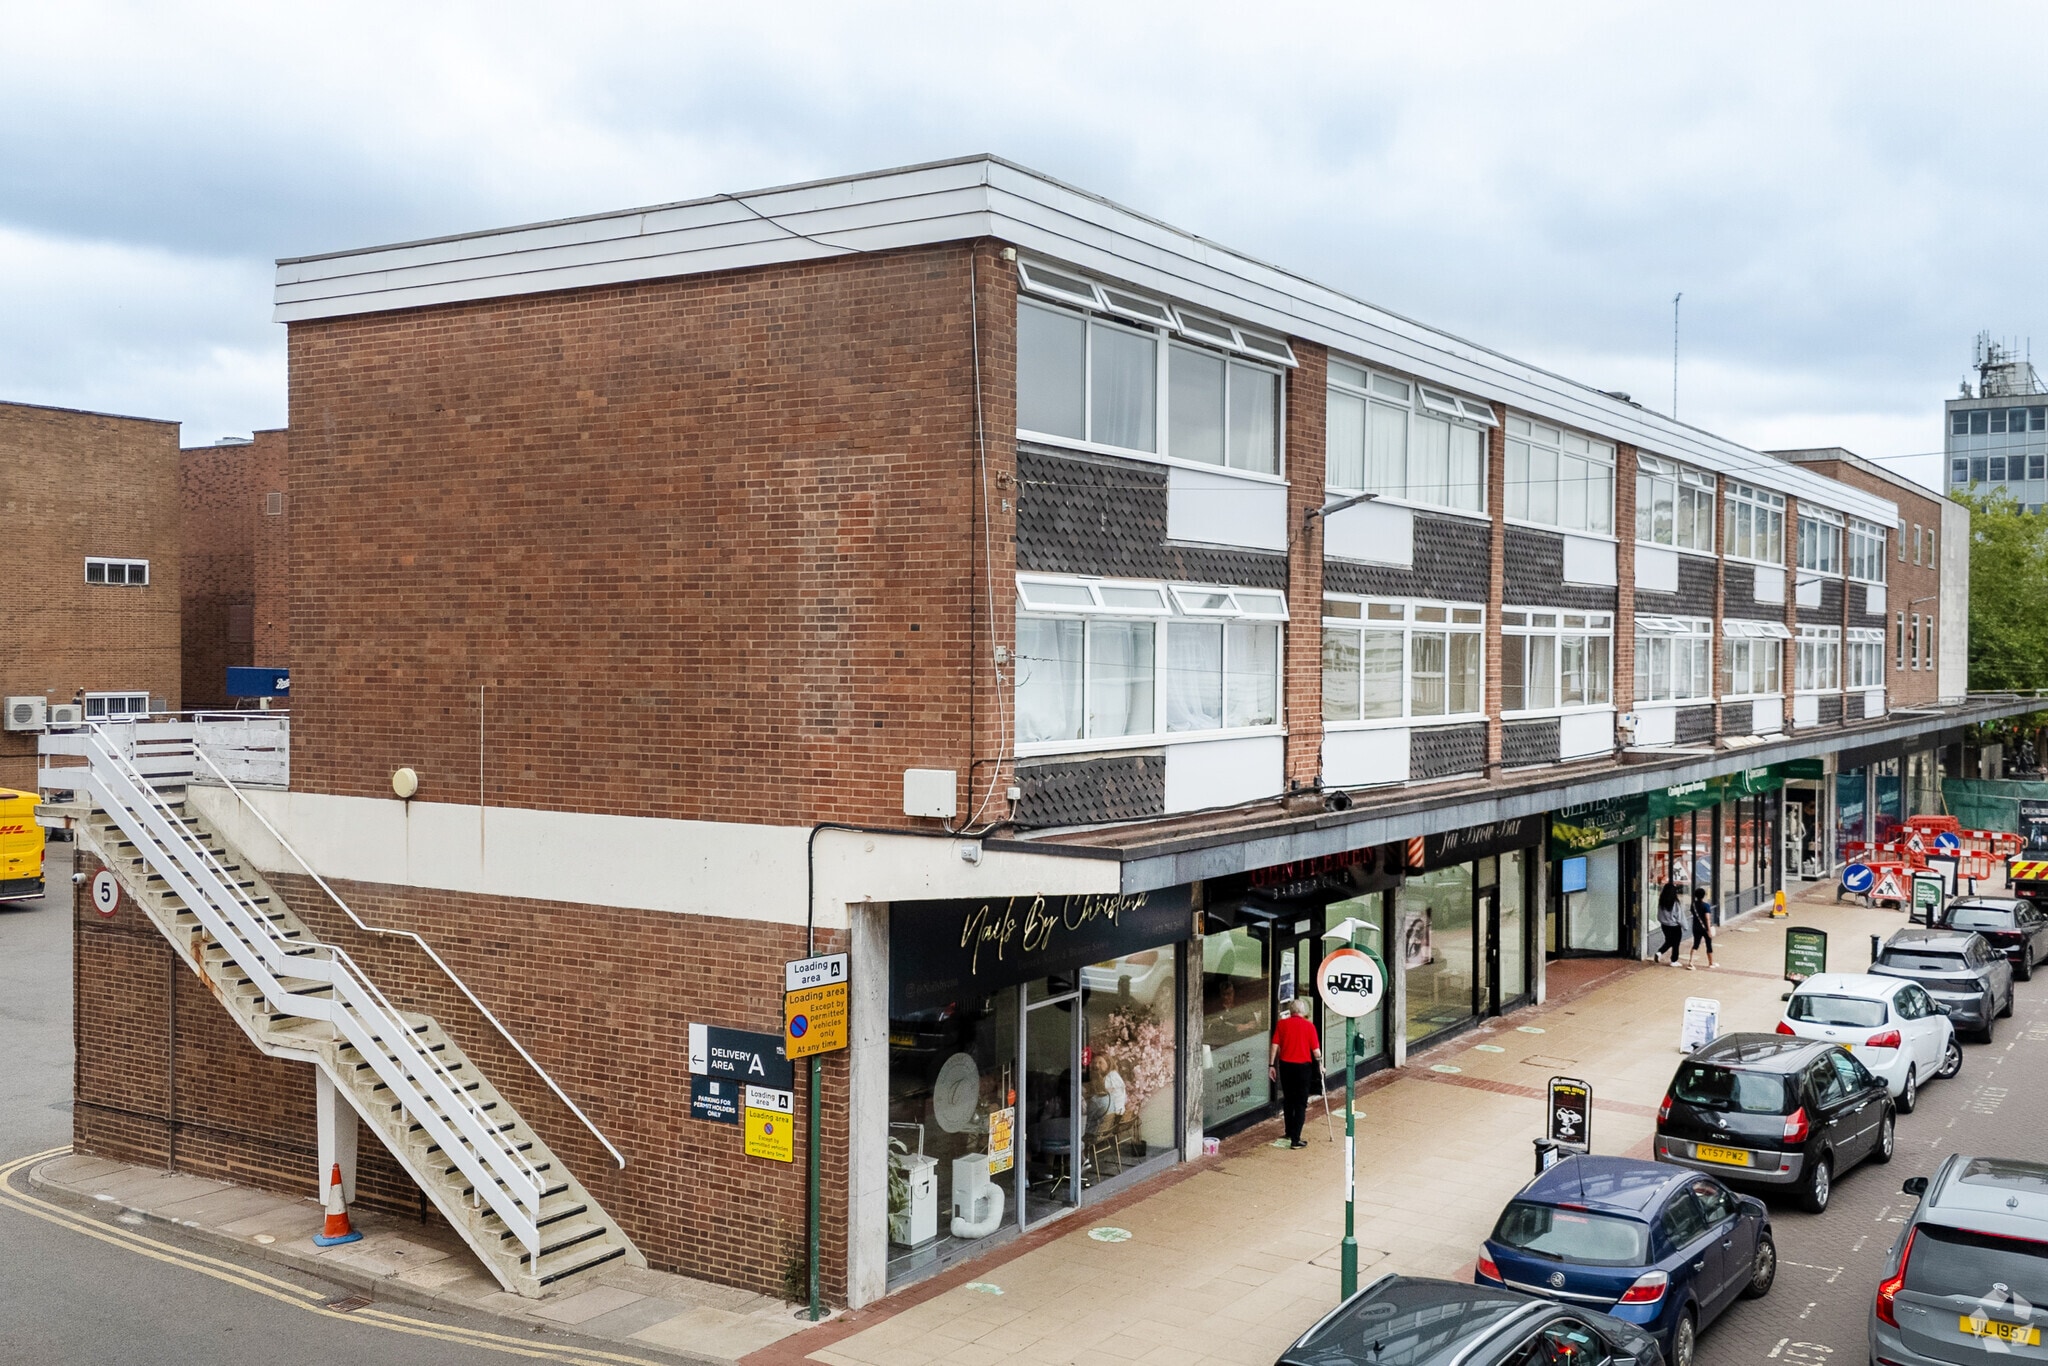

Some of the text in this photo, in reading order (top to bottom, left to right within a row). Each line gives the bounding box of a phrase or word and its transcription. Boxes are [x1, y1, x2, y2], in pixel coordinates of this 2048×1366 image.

[275, 678, 290, 689] Boo
[1596, 810, 1626, 827] CLEANERS
[0, 825, 25, 835] HL
[1462, 825, 1495, 846] Brow
[1497, 820, 1522, 838] Bar
[100, 881, 111, 903] 5
[960, 896, 1017, 976] Nails
[1022, 896, 1059, 952] By
[1063, 890, 1150, 931] Christina
[794, 961, 840, 975] Loading A
[801, 974, 821, 984] area
[1340, 973, 1373, 990] 7.5T
[789, 987, 845, 1005] Loading area
[810, 1000, 845, 1012] Except by
[810, 1008, 845, 1022] permitted
[813, 1019, 842, 1030] vehicles
[819, 1029, 835, 1039] only
[796, 1046, 806, 1054] At
[807, 1043, 820, 1052] any
[822, 1040, 837, 1049] time
[711, 1047, 765, 1077] DELIVERY A
[711, 1060, 735, 1072] AREA
[1218, 1051, 1250, 1074] SKIN FADE
[1216, 1069, 1252, 1092] THREADING
[697, 1095, 720, 1104] PARKING
[750, 1089, 787, 1107] Loading A
[755, 1099, 770, 1107] area
[693, 1101, 736, 1114] PERMIT HOLDERS
[707, 1110, 721, 1118] ONLY
[749, 1110, 789, 1124] Loading area
[1701, 1147, 1744, 1161] KT57 PWZ
[1996, 1323, 2029, 1341] 1957
